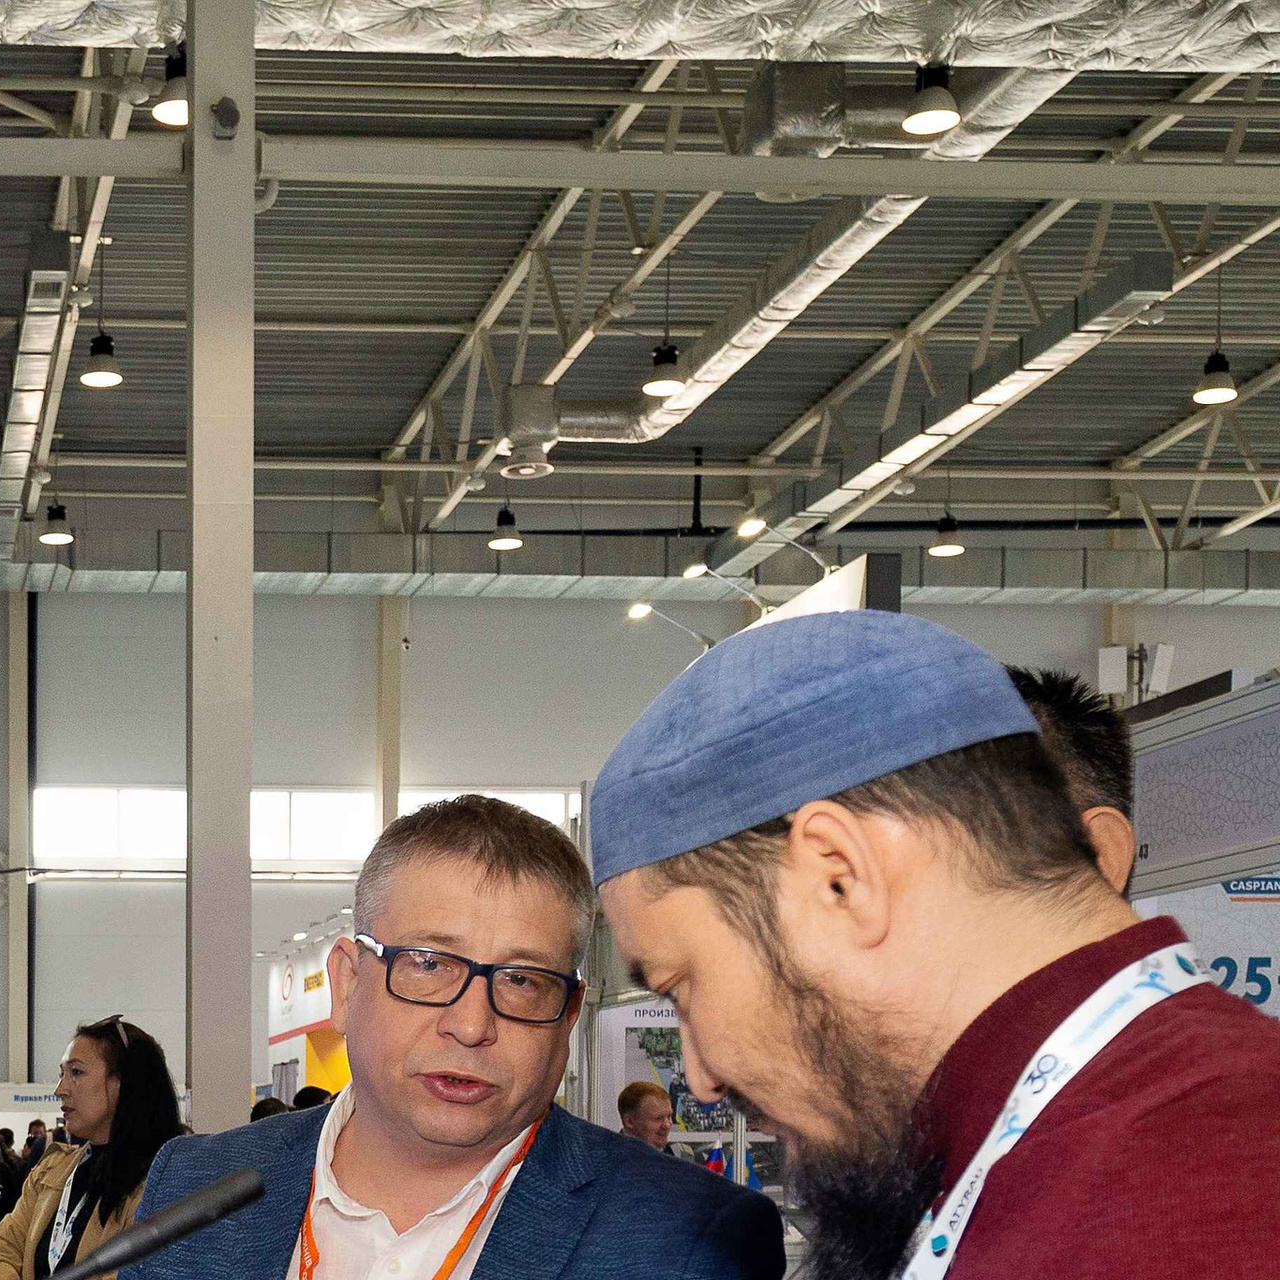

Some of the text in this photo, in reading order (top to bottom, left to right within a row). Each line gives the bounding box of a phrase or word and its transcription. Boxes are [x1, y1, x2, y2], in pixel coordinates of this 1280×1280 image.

[1138, 844, 1149, 860] 43
[1210, 956, 1280, 1005] 25
[634, 1009, 677, 1018] ПРОИЗВ
